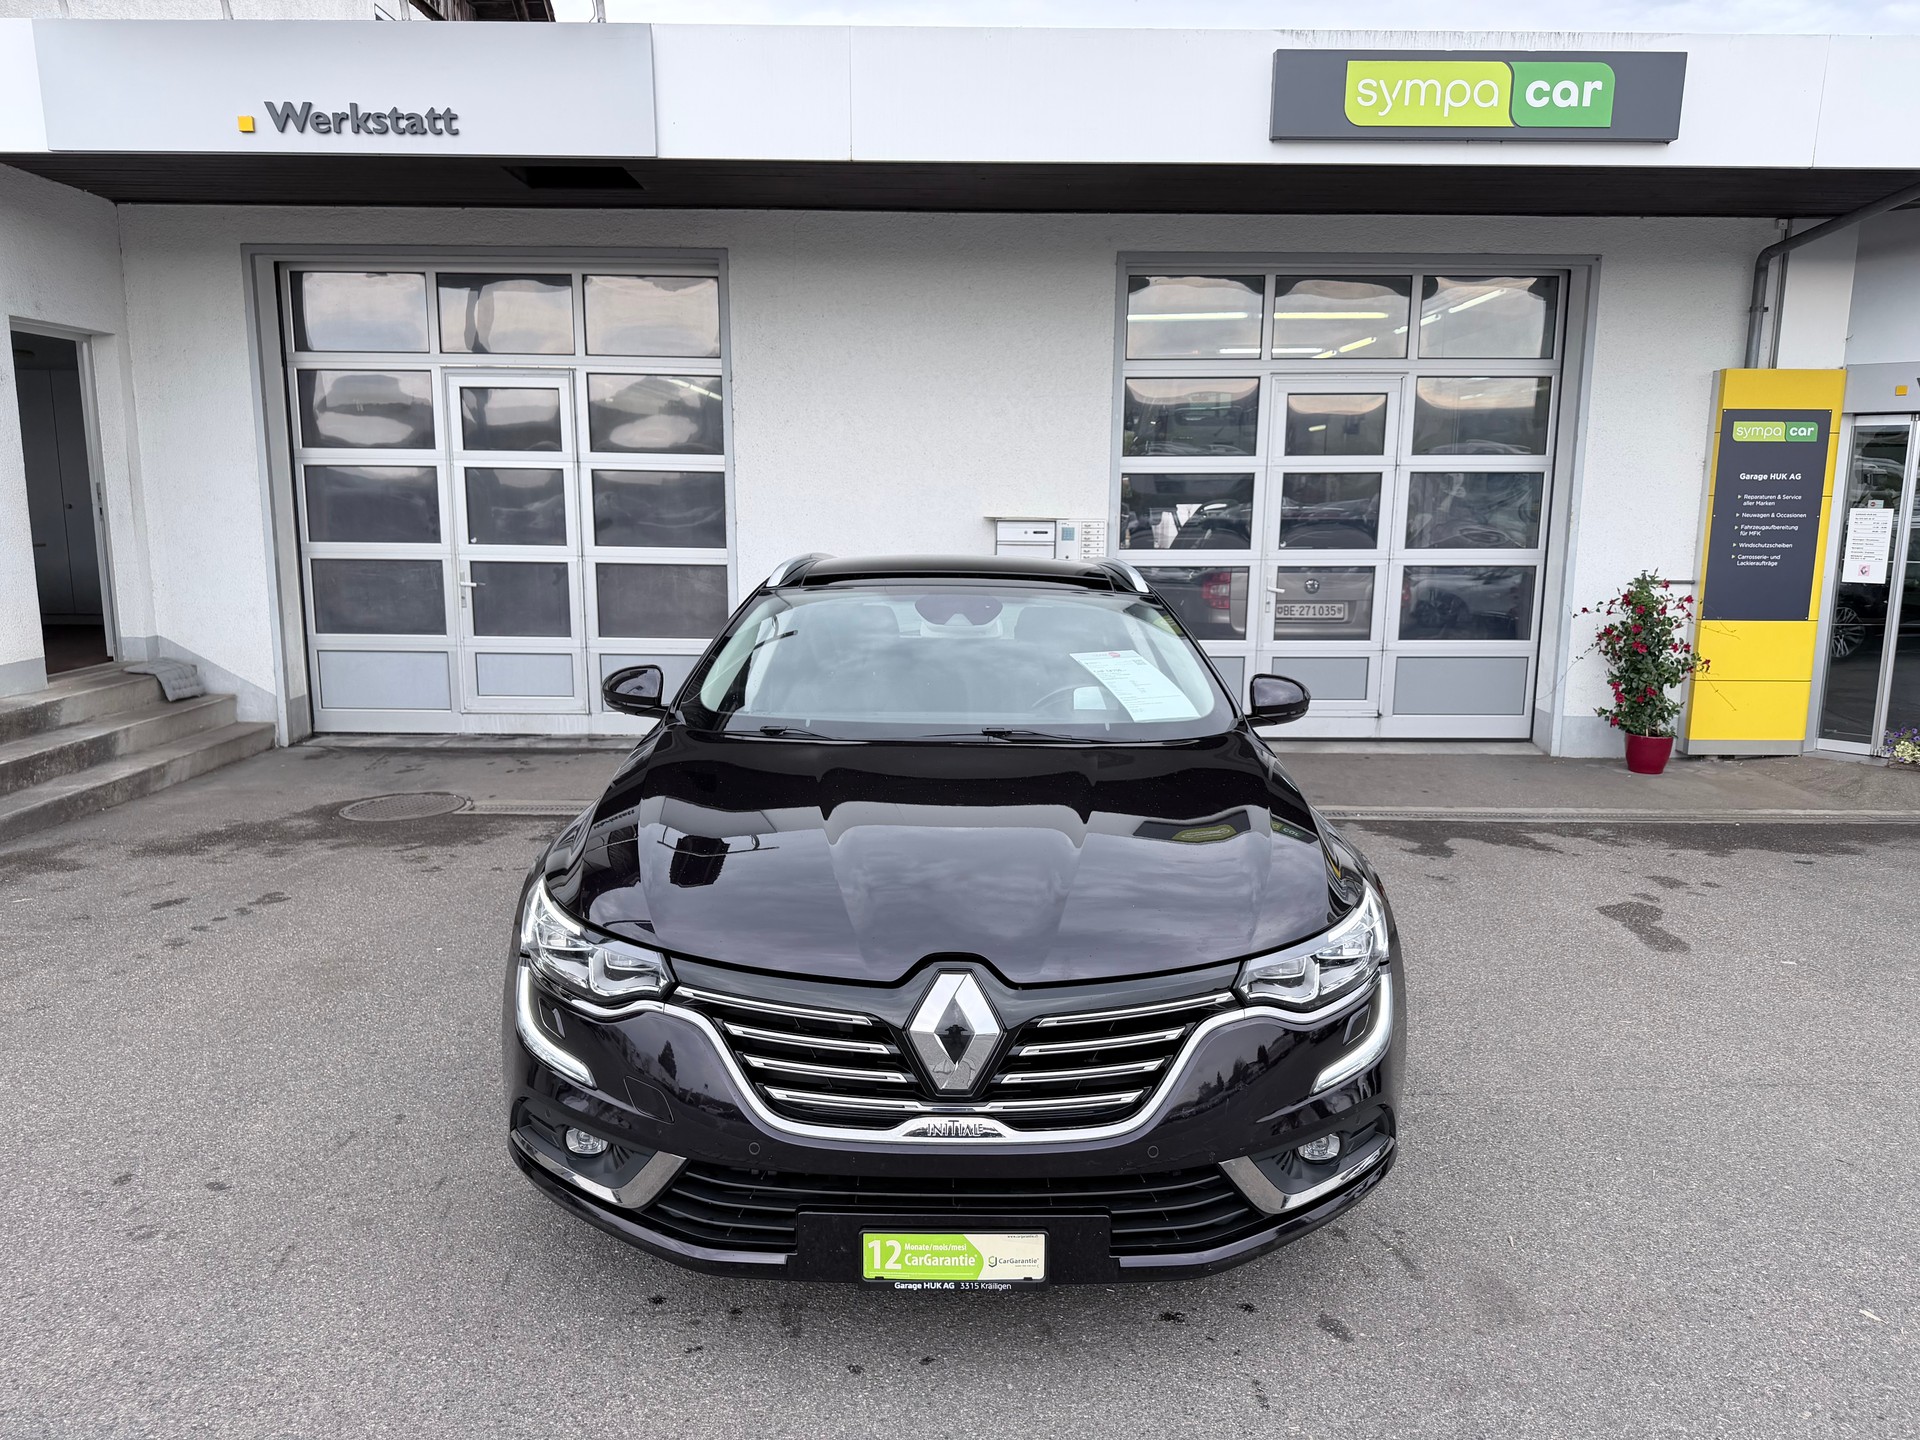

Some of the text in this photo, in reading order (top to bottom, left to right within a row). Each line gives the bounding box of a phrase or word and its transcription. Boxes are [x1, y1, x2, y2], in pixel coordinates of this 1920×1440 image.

[1356, 77, 1603, 117] sympa car
[264, 100, 460, 136] Werkstatt
[1736, 426, 1814, 439] sympa car
[1739, 472, 1802, 481] Garage HUK AG
[1740, 524, 1799, 532] Fahrzeugaufbereitung
[927, 1120, 983, 1137] INITIALE
[904, 1243, 967, 1251] Monate/mois/mesi
[867, 1239, 902, 1270] 12
[894, 1282, 923, 1291] Garage
[923, 1282, 941, 1290] HUK
[942, 1282, 955, 1290] AG
[959, 1282, 980, 1290] 3315
